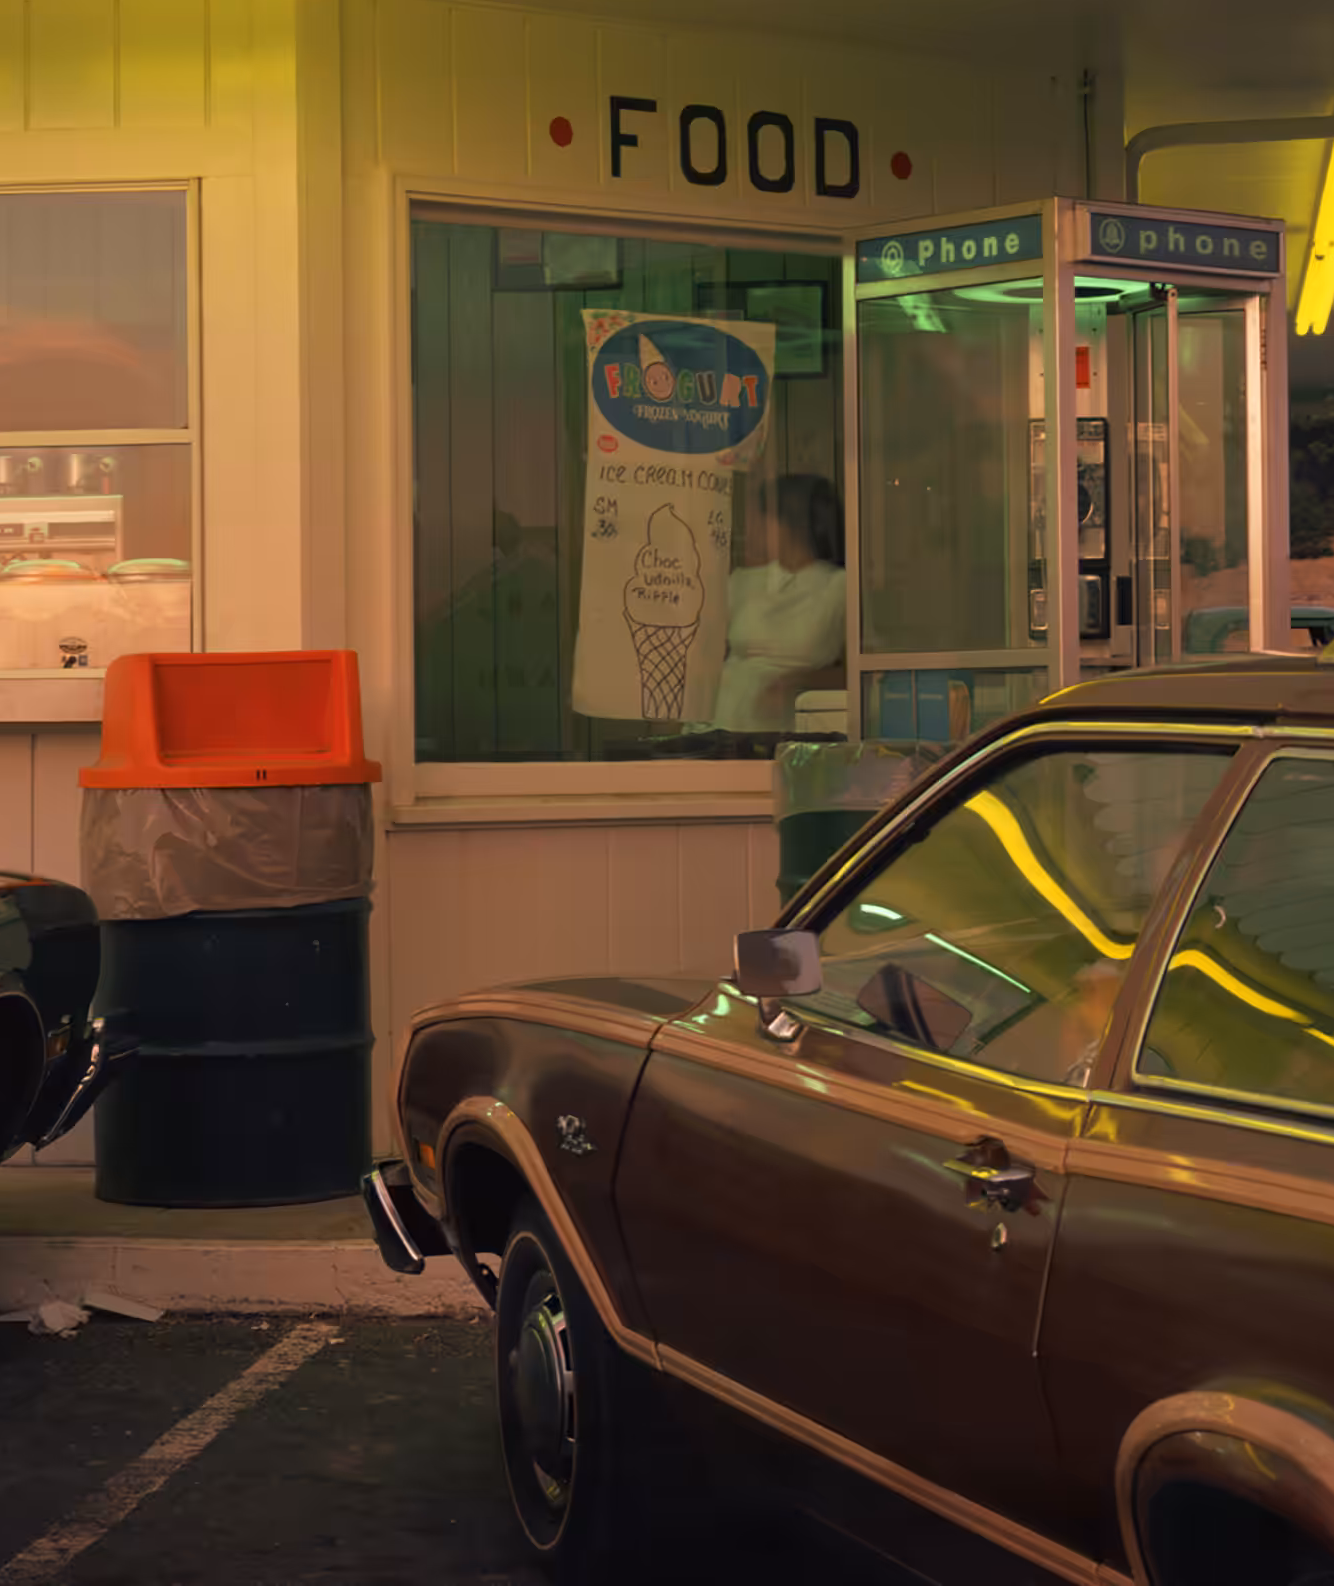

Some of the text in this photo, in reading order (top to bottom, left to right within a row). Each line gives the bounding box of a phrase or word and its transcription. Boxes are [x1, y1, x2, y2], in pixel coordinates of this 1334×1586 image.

[608, 95, 860, 199] FOOD
[1139, 226, 1268, 260] phone
[641, 548, 683, 570] Choc
